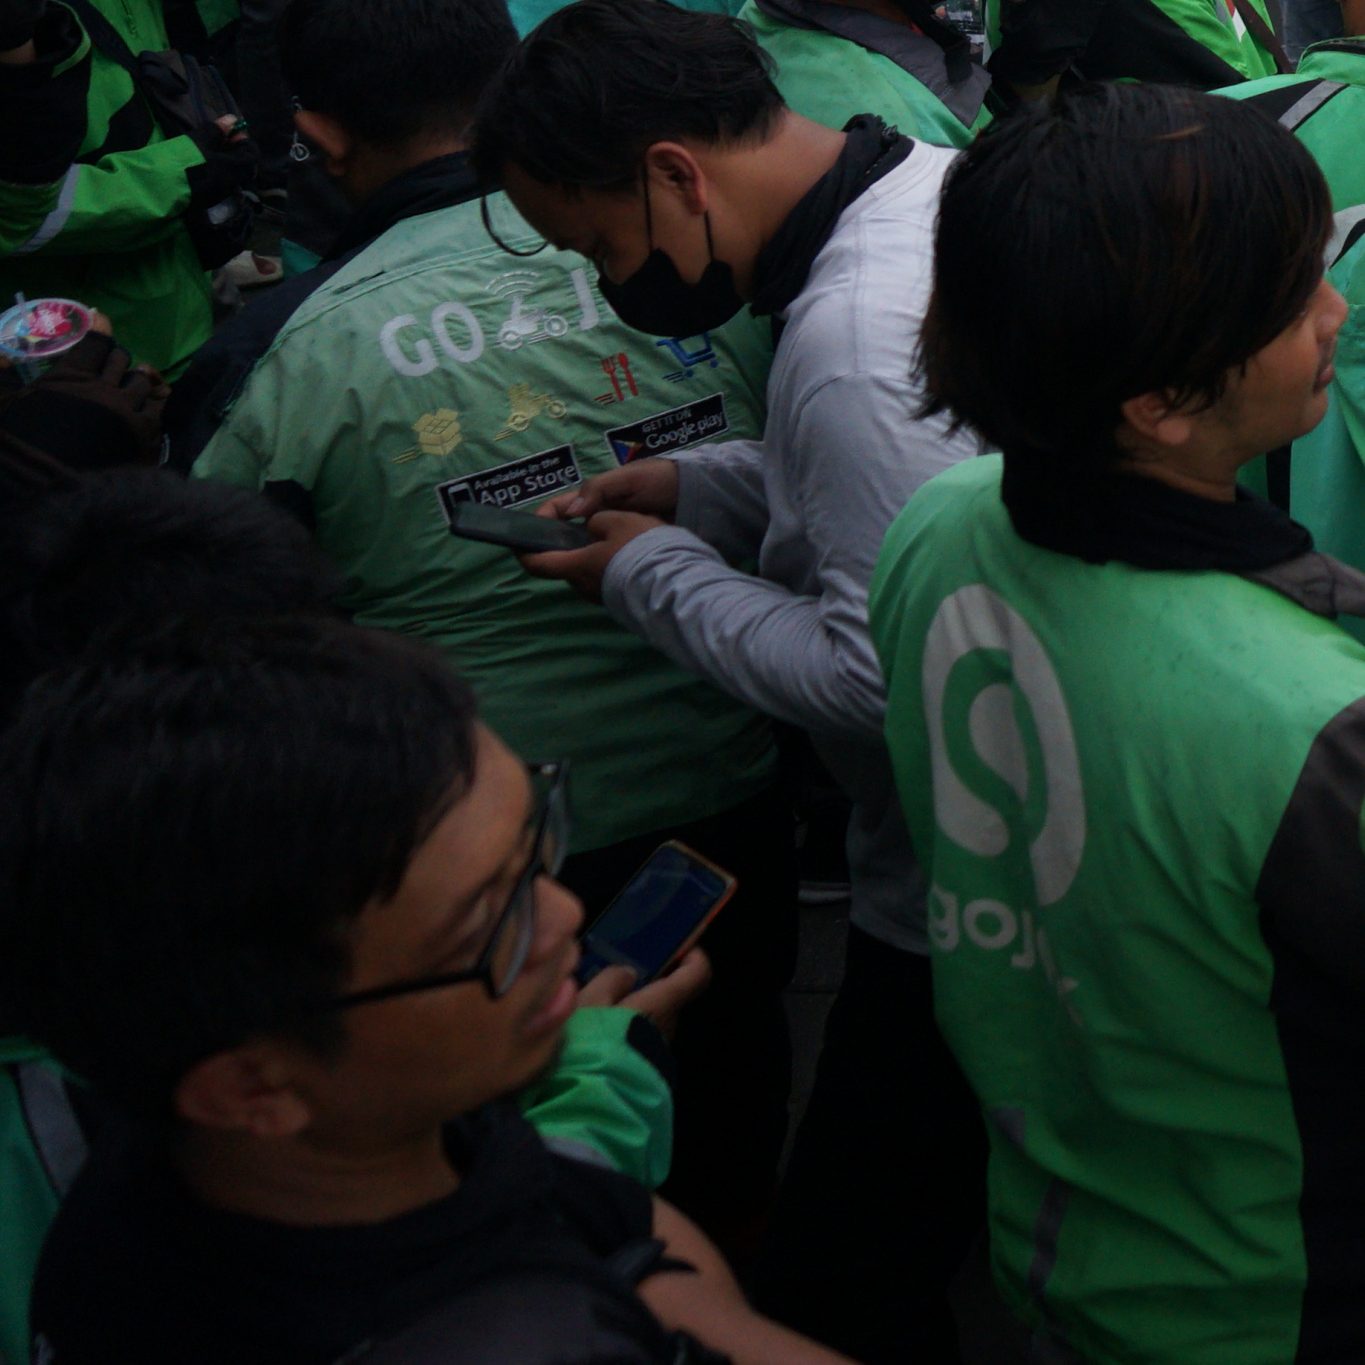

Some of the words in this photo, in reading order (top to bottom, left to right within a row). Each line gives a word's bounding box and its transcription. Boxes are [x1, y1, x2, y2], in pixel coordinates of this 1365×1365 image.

[381, 301, 485, 377] GO
[645, 418, 698, 449] Google
[697, 412, 724, 436] play
[480, 482, 522, 508] App
[524, 465, 577, 494] Store
